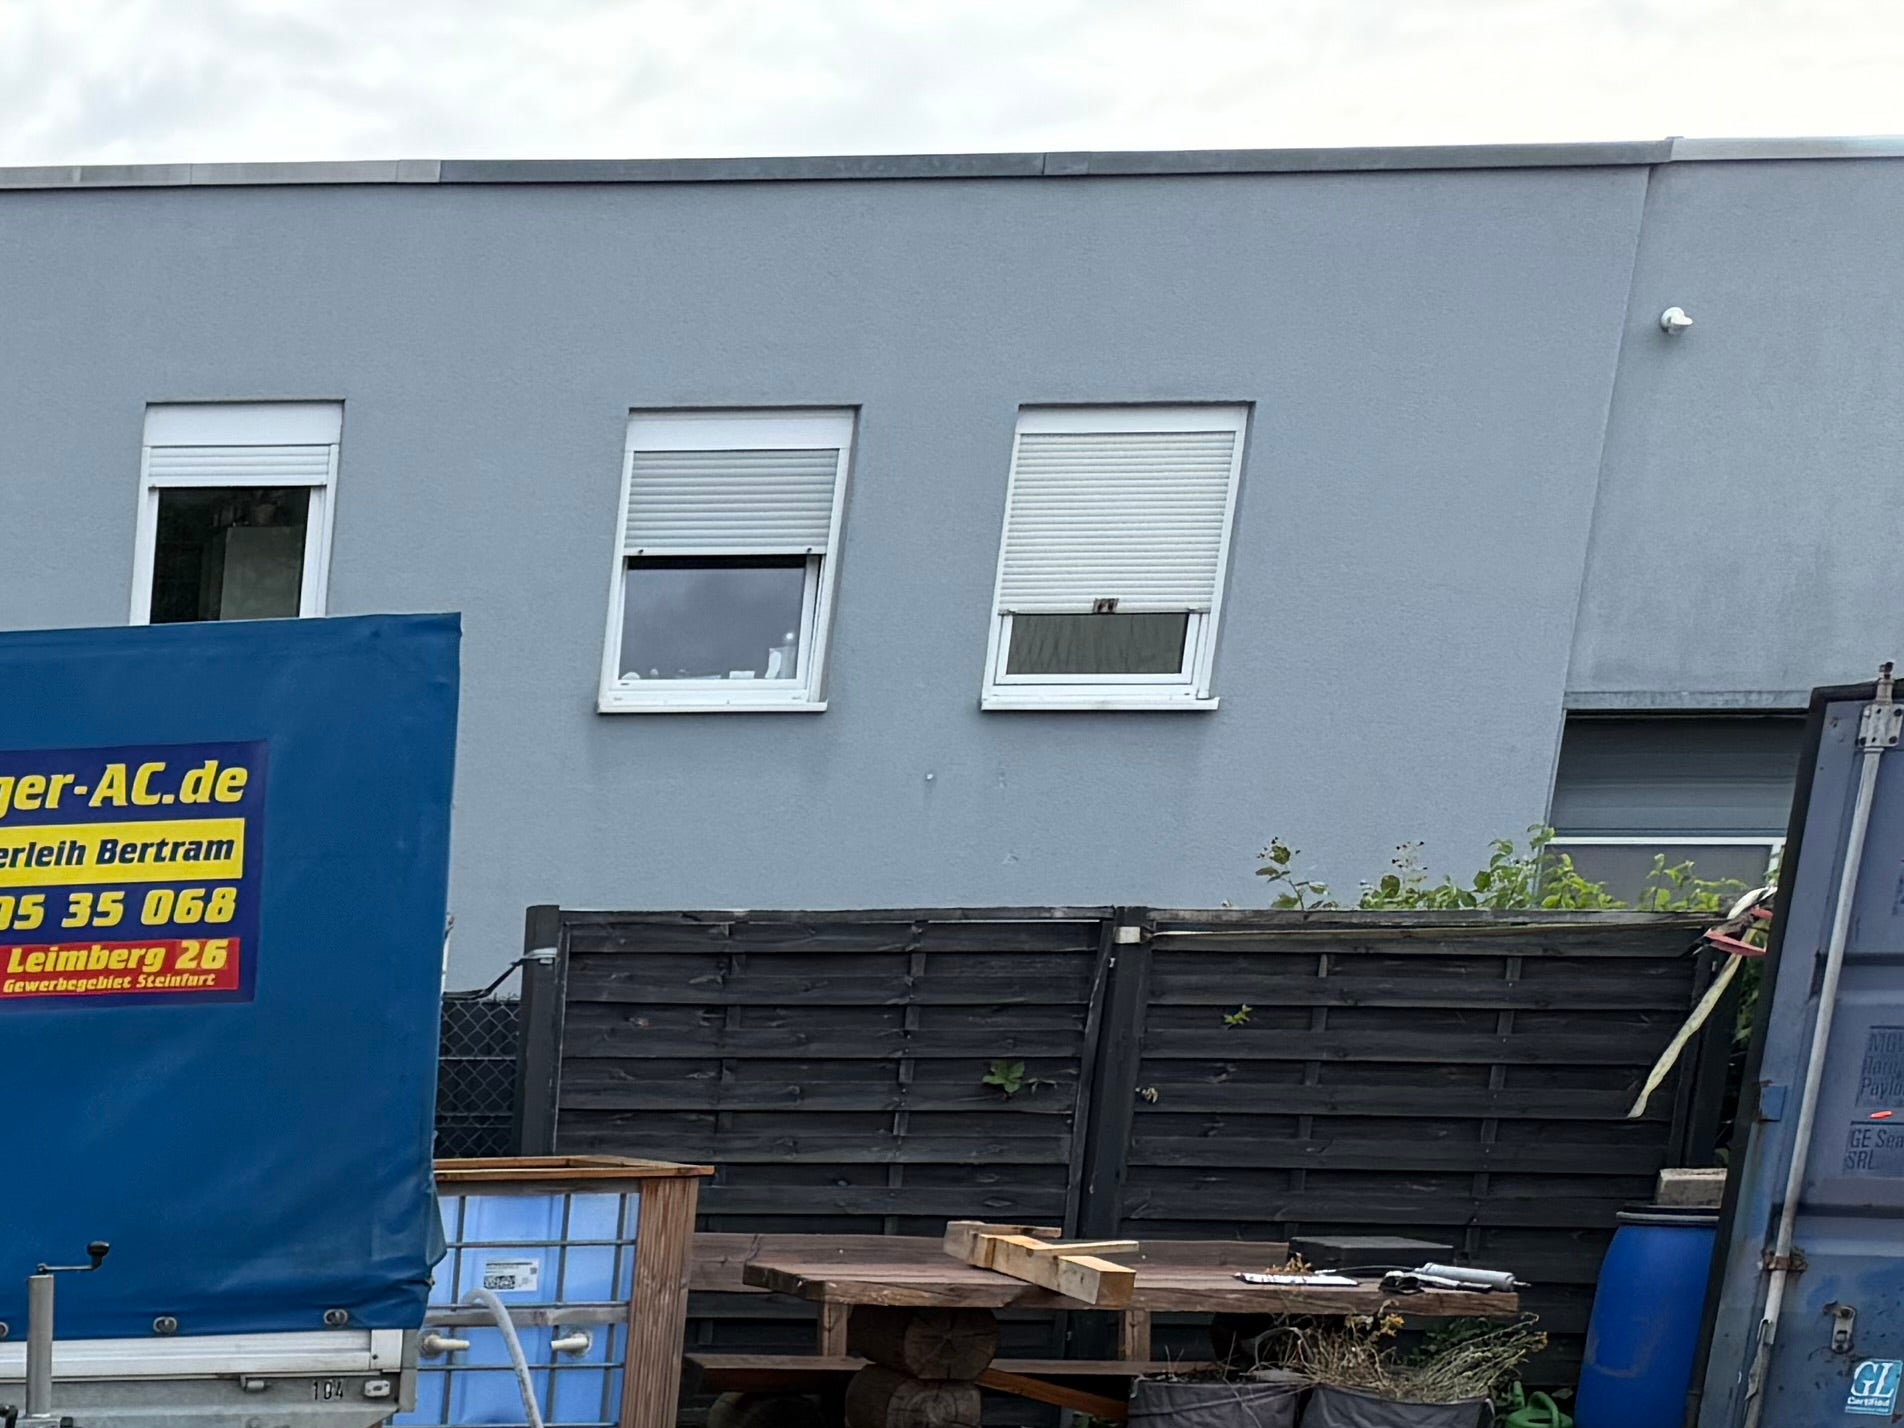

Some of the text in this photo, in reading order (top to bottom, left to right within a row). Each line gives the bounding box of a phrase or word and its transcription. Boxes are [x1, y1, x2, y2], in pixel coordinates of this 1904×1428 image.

[95, 837, 235, 865] Bertram
[62, 891, 125, 929] 35
[140, 887, 238, 925] 068
[7, 948, 166, 975] Leimberg
[174, 939, 229, 970] 26
[2, 973, 216, 993] Gewerbegebiet Steinfurt
[1850, 1129, 1872, 1149] GE
[313, 1381, 344, 1401] 104
[1851, 1361, 1894, 1397] GL
